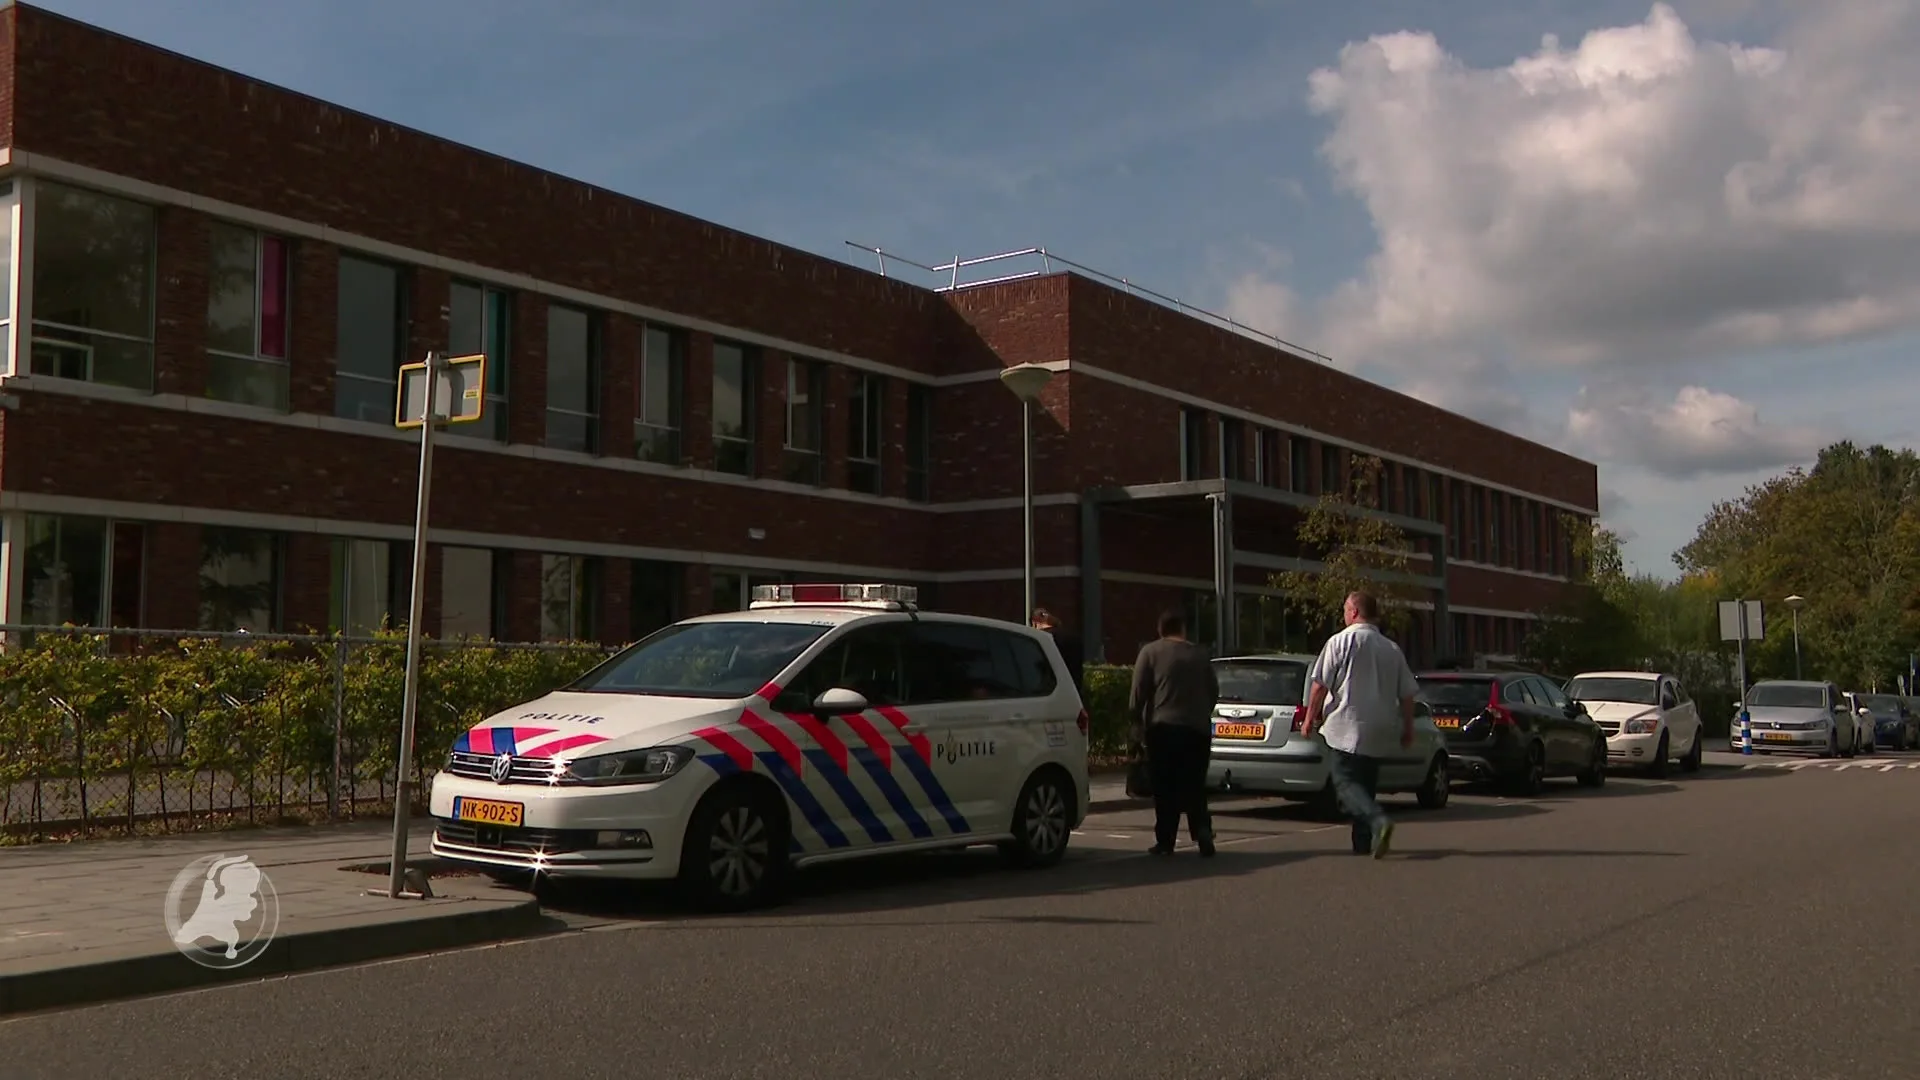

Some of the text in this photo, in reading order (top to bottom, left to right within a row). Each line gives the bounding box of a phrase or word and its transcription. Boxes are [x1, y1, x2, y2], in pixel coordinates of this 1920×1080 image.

[518, 713, 605, 725] POLITIE
[1217, 725, 1262, 736] 06-NP-TB
[937, 740, 995, 765] POLITIE
[462, 801, 518, 823] NK-902-S
